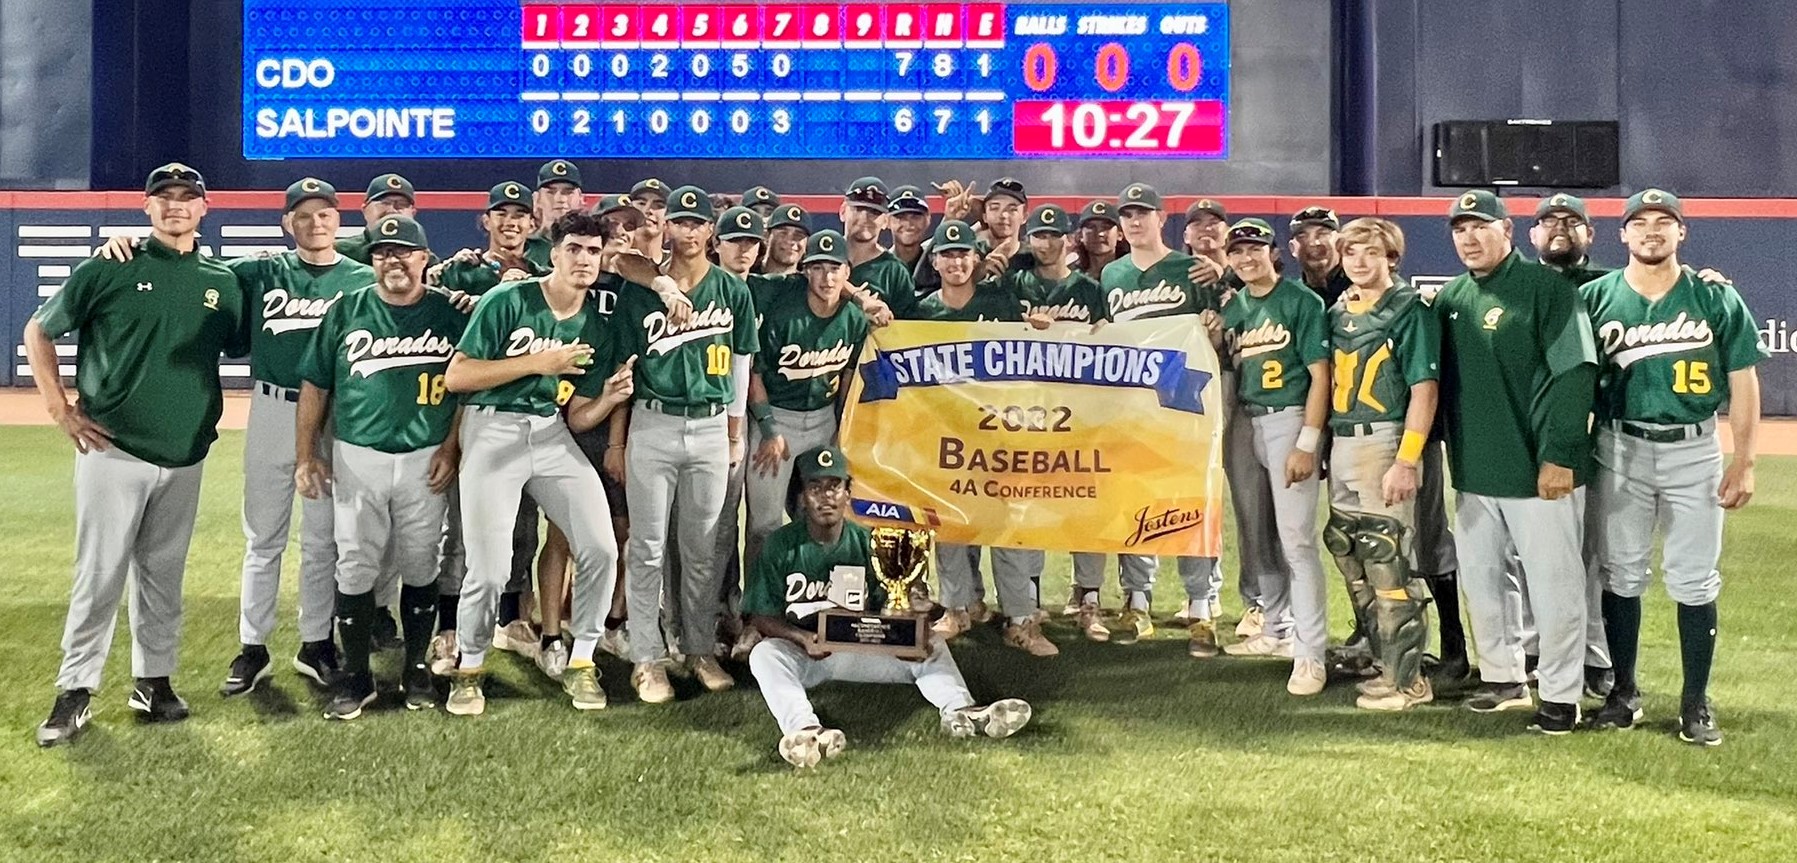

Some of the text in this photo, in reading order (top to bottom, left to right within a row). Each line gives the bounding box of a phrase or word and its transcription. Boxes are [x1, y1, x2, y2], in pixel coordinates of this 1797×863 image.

[536, 13, 547, 37] 1
[574, 13, 589, 37] 2
[612, 13, 629, 37] 3
[652, 13, 668, 37] 4
[692, 13, 709, 37] 5
[732, 13, 748, 37] 6
[773, 13, 791, 37] 7
[813, 13, 829, 37] 8
[857, 13, 872, 37] 9
[895, 13, 913, 37] R
[978, 13, 994, 37] E
[256, 53, 990, 89] CDO 0 0 0 2 0 5 0 7 8 1
[1023, 42, 1202, 92] 0 0 0
[256, 107, 990, 138] SALPOINTE 0 2 1 0 0 0 3 6 7 1
[1041, 103, 1195, 148] 10:27
[552, 162, 568, 176] C
[301, 177, 321, 193] C
[504, 184, 520, 199] C
[1128, 186, 1142, 199] C
[681, 192, 698, 208] C
[1460, 193, 1477, 210] C
[736, 212, 752, 229] C
[787, 206, 801, 221] C
[1041, 208, 1055, 224] C
[380, 219, 399, 236] C
[946, 226, 960, 240] C
[819, 236, 834, 251] C
[1107, 279, 1186, 317] Dorados
[1599, 311, 1714, 355] Dorados
[345, 328, 455, 362] Dorados
[706, 344, 731, 376] 10
[889, 341, 1164, 386] STATE CHAMPIONS
[1262, 360, 1283, 389] 2
[1672, 359, 1712, 394] 15
[416, 372, 447, 406] 18
[978, 405, 1072, 432] 2022
[817, 450, 834, 467] C
[949, 479, 978, 497] 4A
[865, 502, 900, 519] AIA
[1124, 505, 1204, 548] Jostens
